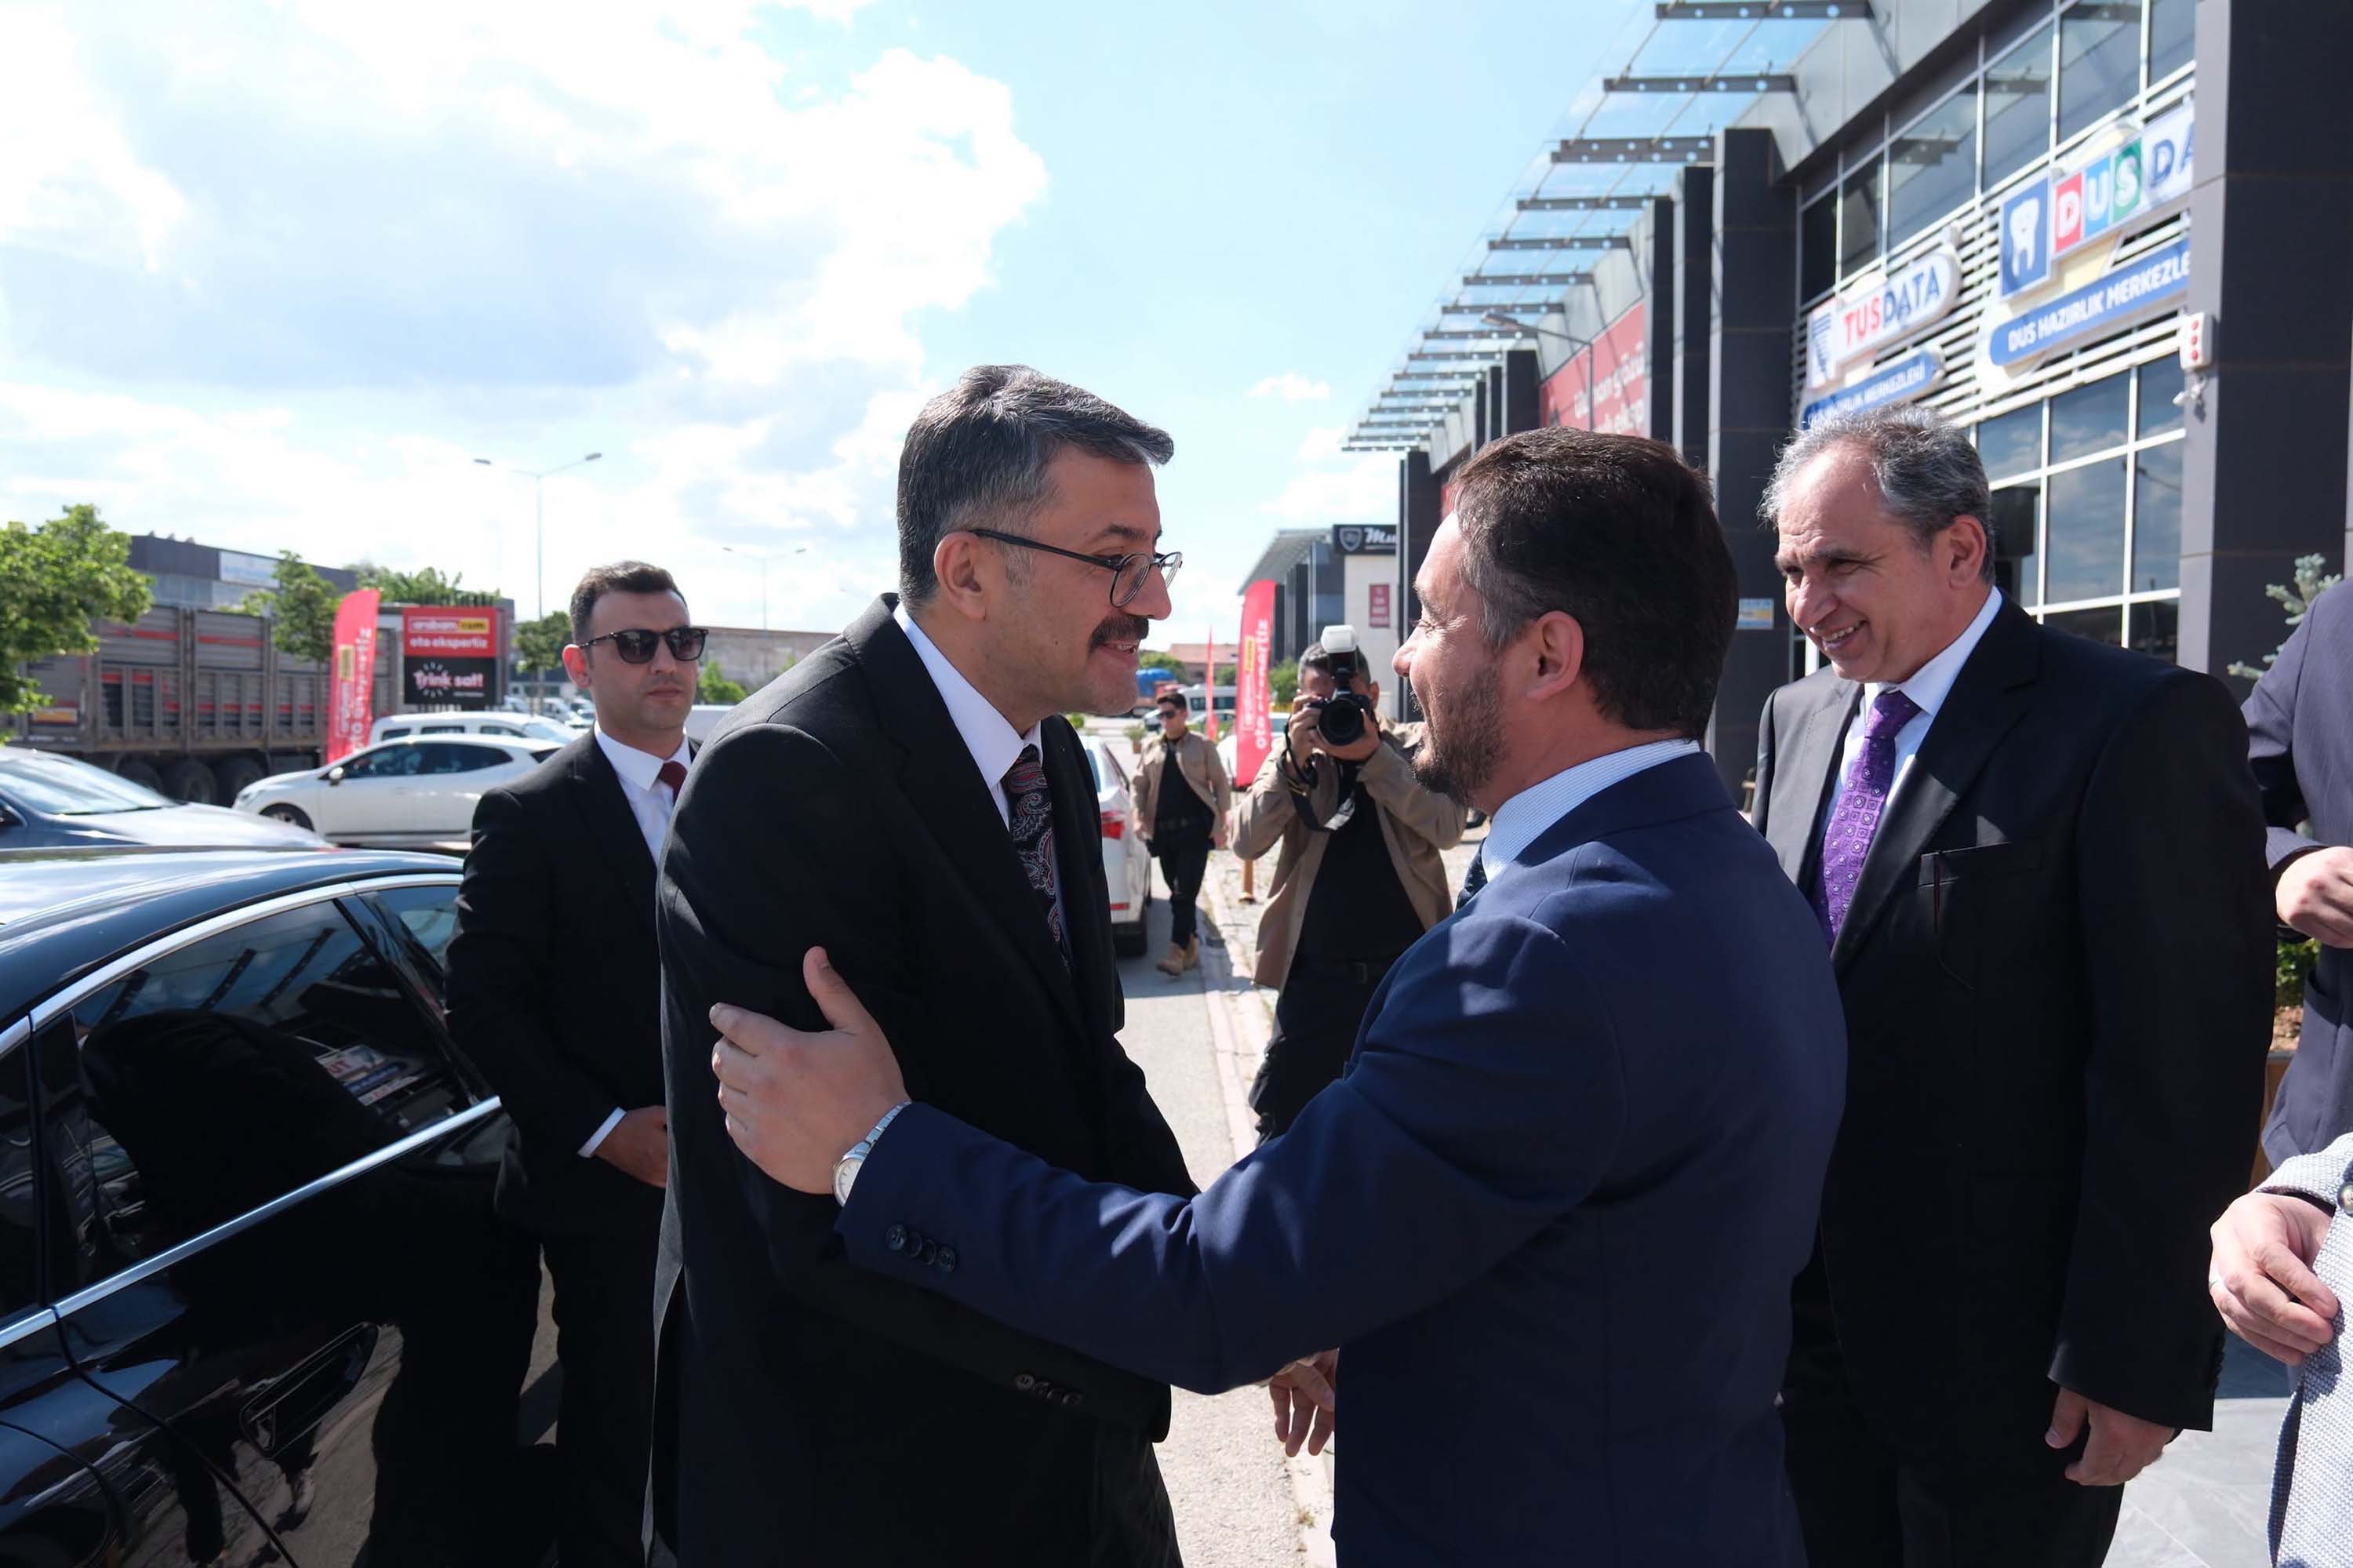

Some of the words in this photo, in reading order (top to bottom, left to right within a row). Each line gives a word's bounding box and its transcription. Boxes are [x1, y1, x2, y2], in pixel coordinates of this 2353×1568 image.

[1845, 265, 1940, 347] TUSDATA
[2008, 319, 2037, 351] DUS
[2038, 290, 2104, 340] HAZIRLIK
